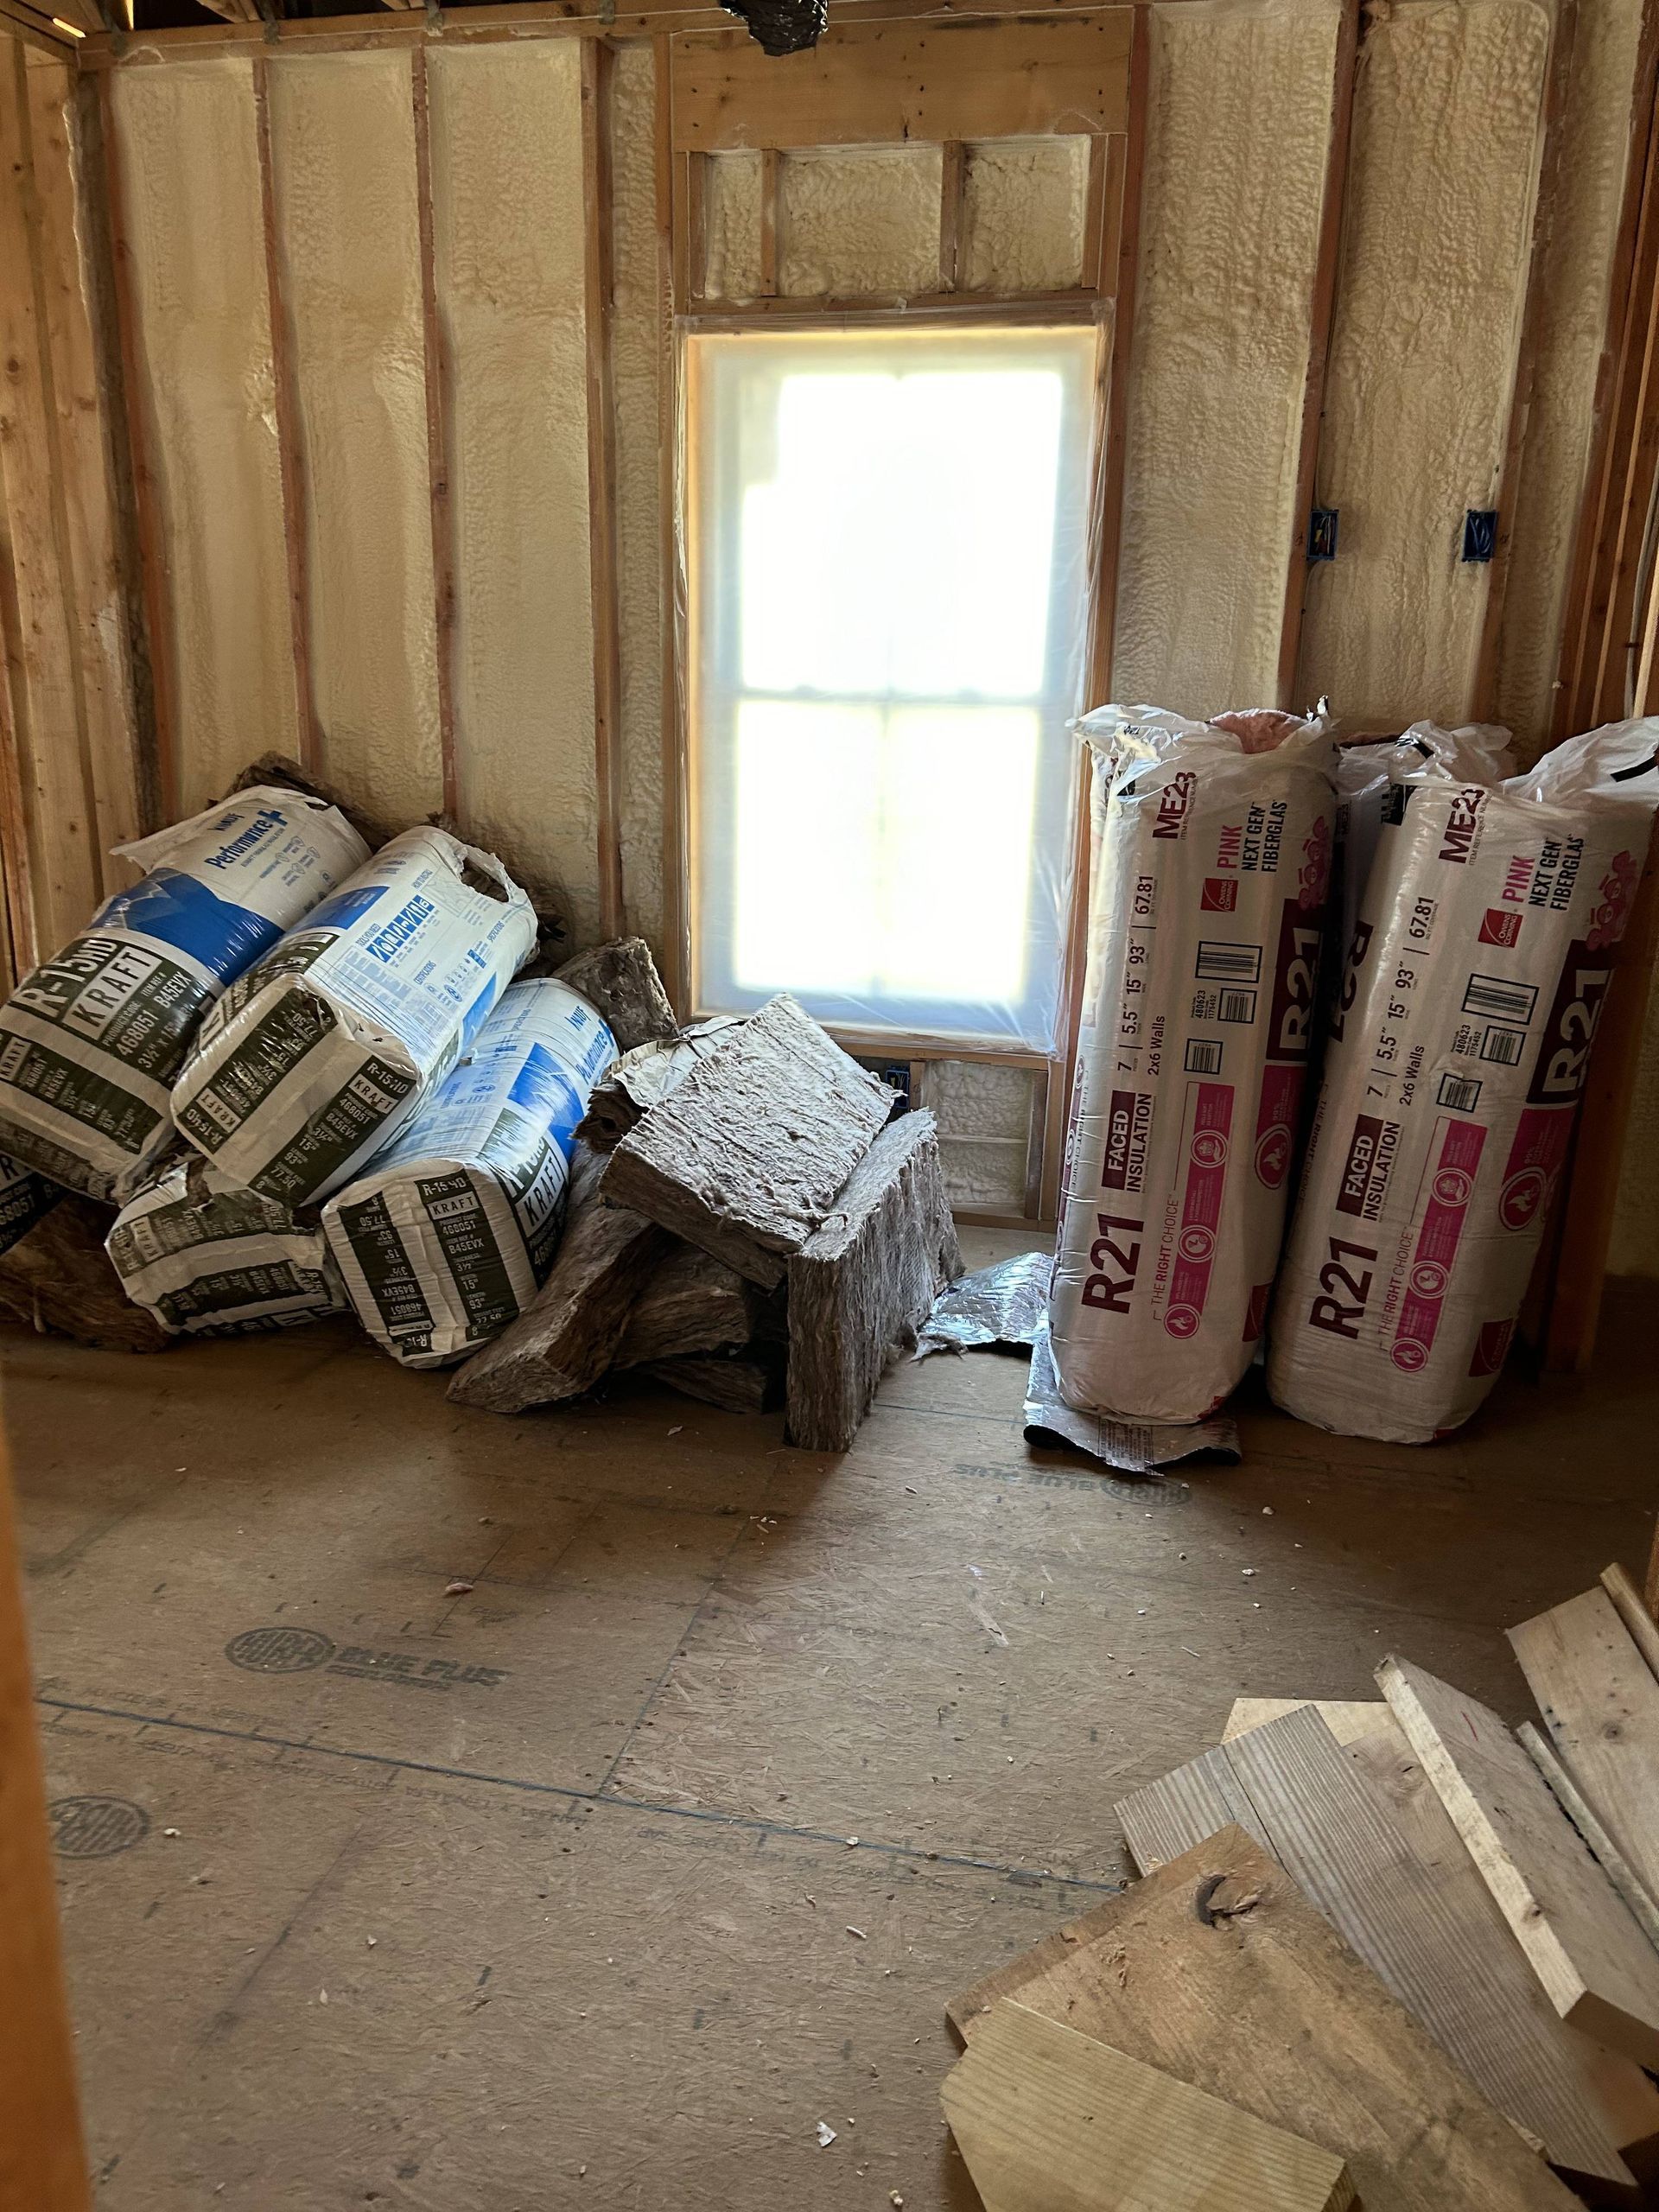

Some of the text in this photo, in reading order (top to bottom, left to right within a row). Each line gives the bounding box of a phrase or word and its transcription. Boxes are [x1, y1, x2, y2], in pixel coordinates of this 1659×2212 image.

[1153, 772, 1196, 839] ME23
[1439, 789, 1485, 863] ME23
[1217, 825, 1243, 869] PINK
[1242, 837, 1260, 871] NEXT
[1218, 881, 1227, 905] OWENS
[1224, 880, 1234, 910] CORNING
[1503, 855, 1535, 902] PINK
[1529, 871, 1554, 906] NEXT
[1499, 914, 1510, 939] OWENS
[1504, 915, 1518, 944] CORNING
[22, 938, 118, 1019] R-15HD
[72, 951, 151, 1027] KRAFT
[154, 971, 192, 1009] B45EVX
[1117, 1061, 1132, 1071] 7
[1135, 875, 1154, 915] 67.81
[1279, 927, 1320, 1049] R21
[1195, 989, 1206, 1019] 480623
[1367, 1086, 1383, 1098] 7
[1409, 897, 1434, 938] 67.81
[116, 1009, 159, 1056] 468051
[292, 1013, 318, 1037] 77.50
[1455, 1024, 1471, 1055] 480623
[1542, 969, 1610, 1092] R21
[0, 1040, 26, 1077] KRAFT
[1147, 1015, 1165, 1076] 2x6 Walls
[1470, 1032, 1482, 1056] 1175452
[1400, 1045, 1425, 1106] 2x6 Walls
[201, 1094, 236, 1126] KRAFT
[340, 1098, 371, 1123] 468051
[353, 1080, 393, 1110] KRAFT
[326, 1113, 359, 1140] B45EVX
[1107, 1109, 1129, 1172] FACED
[1127, 1093, 1152, 1193] INSULATION
[1308, 1123, 1321, 1159] RIGHT
[270, 1166, 296, 1188] 77.50
[1344, 1135, 1373, 1198] FACED
[1363, 1122, 1401, 1222] INSULATION
[433, 1196, 474, 1216] KRAFT
[524, 1156, 563, 1227] KRAFT
[135, 1222, 159, 1257] KRAFT
[183, 1208, 204, 1241] B45EVX
[359, 1216, 386, 1227] 77.50
[442, 1220, 476, 1236] 468051
[448, 1237, 485, 1255] B45EVX
[1081, 1213, 1144, 1314] R21
[1151, 1199, 1179, 1306] THE RIGHT CHOICE
[382, 1284, 416, 1297] B45EVX
[1309, 1236, 1378, 1339] R21
[1377, 1313, 1391, 1337] THE
[1384, 1275, 1401, 1315] RIGHT
[1393, 1231, 1414, 1276] CHOICE
[391, 1303, 422, 1313] 468051
[472, 1326, 478, 1336] 8
